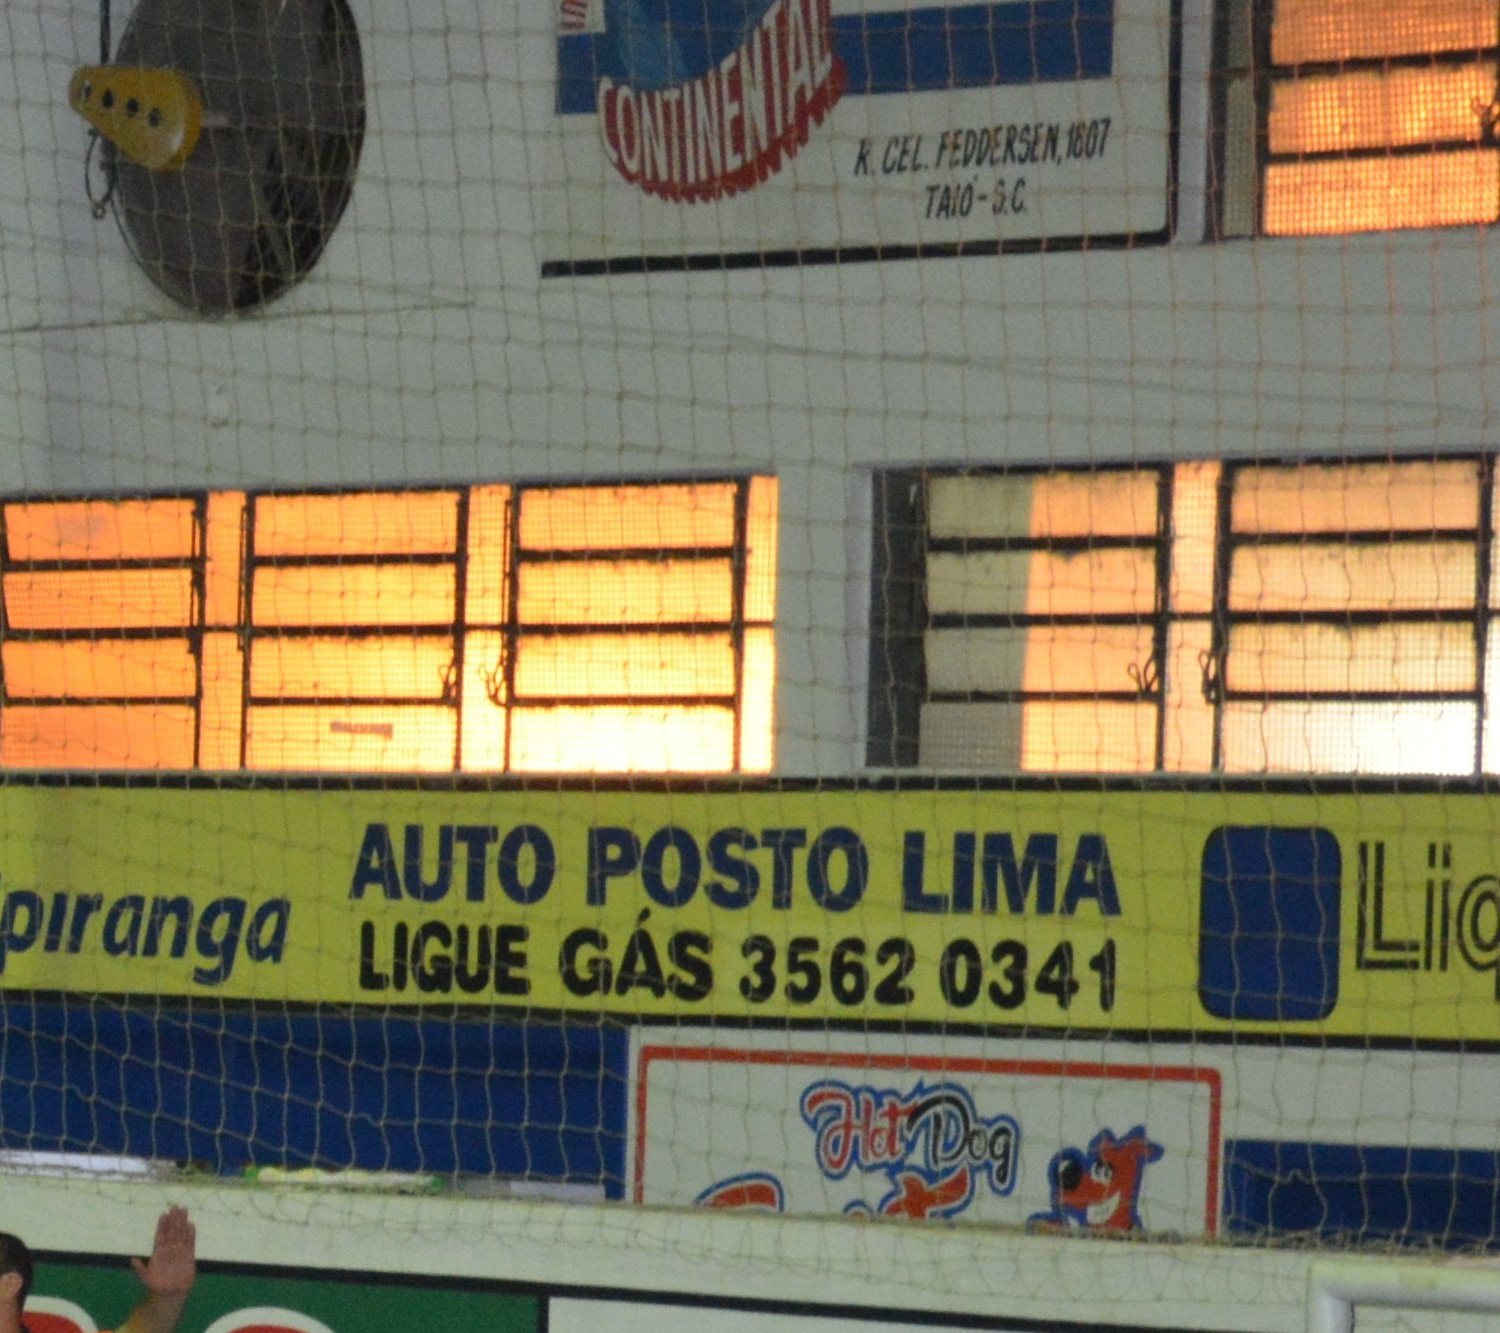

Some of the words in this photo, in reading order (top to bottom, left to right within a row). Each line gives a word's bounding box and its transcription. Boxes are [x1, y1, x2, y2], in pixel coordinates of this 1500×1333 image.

[599, 0, 834, 188] CONTINENTAL
[882, 129, 929, 173] CEL.
[924, 173, 974, 219] TAIÓ
[349, 822, 555, 906] AUTO
[586, 825, 870, 913] POSTO
[901, 831, 1122, 918] LIMA
[359, 919, 530, 996] LIGUE
[560, 907, 714, 1002] GÁS
[739, 937, 915, 1006] 3562
[940, 938, 1118, 1012] 0341
[803, 1080, 914, 1178] Hot
[905, 1082, 1015, 1192] Dog
